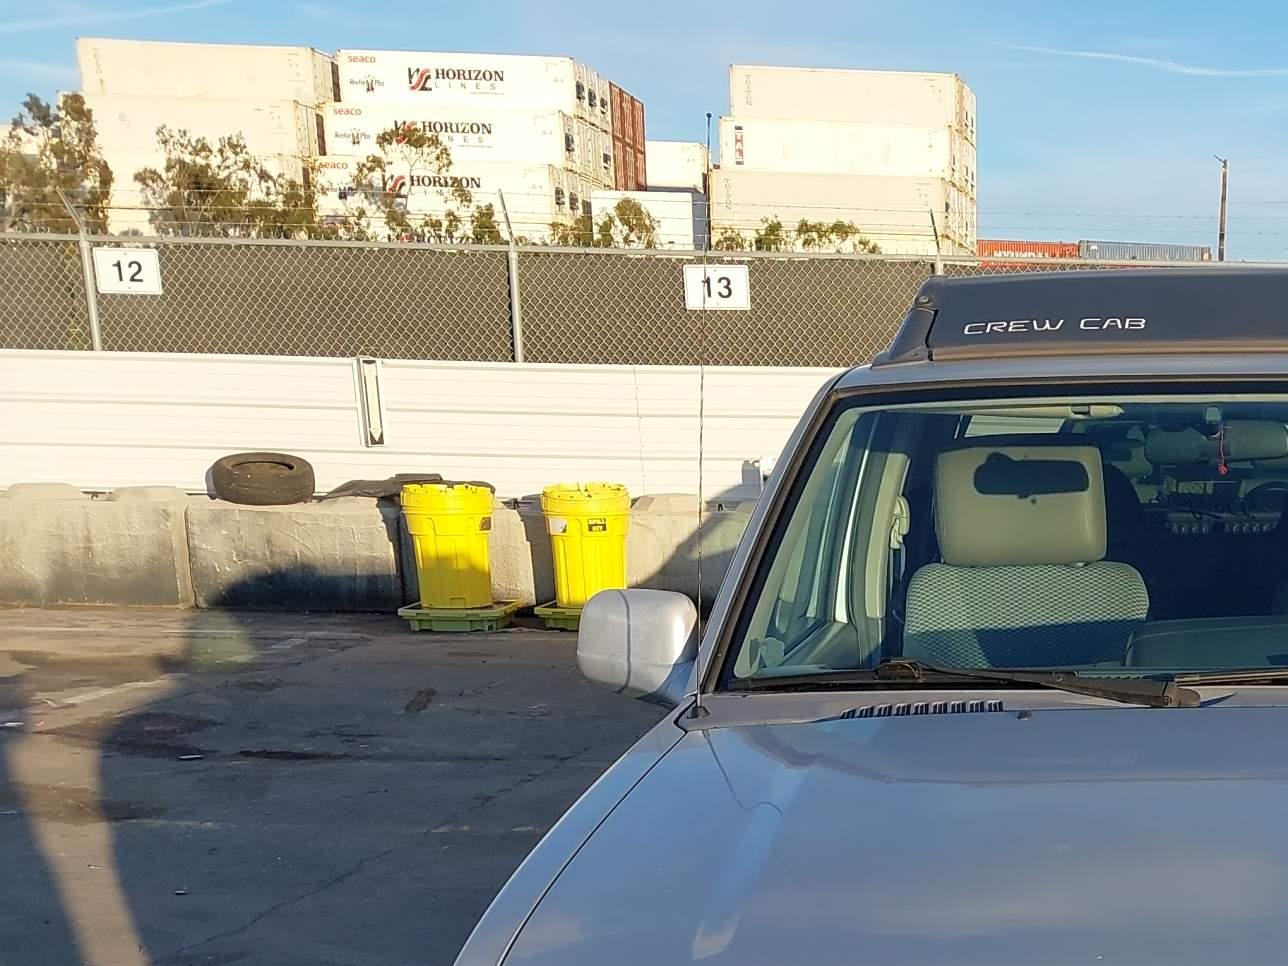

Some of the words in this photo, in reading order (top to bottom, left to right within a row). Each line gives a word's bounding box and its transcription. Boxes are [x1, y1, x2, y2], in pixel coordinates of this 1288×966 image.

[348, 55, 376, 63] seaco
[435, 68, 504, 82] HORIZON
[435, 83, 496, 91] LINES
[333, 107, 362, 116] seaco
[421, 121, 492, 135] HORIZON
[410, 175, 481, 189] HORIZON
[112, 260, 144, 282] 12
[701, 276, 732, 298] 13
[963, 319, 1064, 335] CREW
[1080, 318, 1146, 330] CAB
